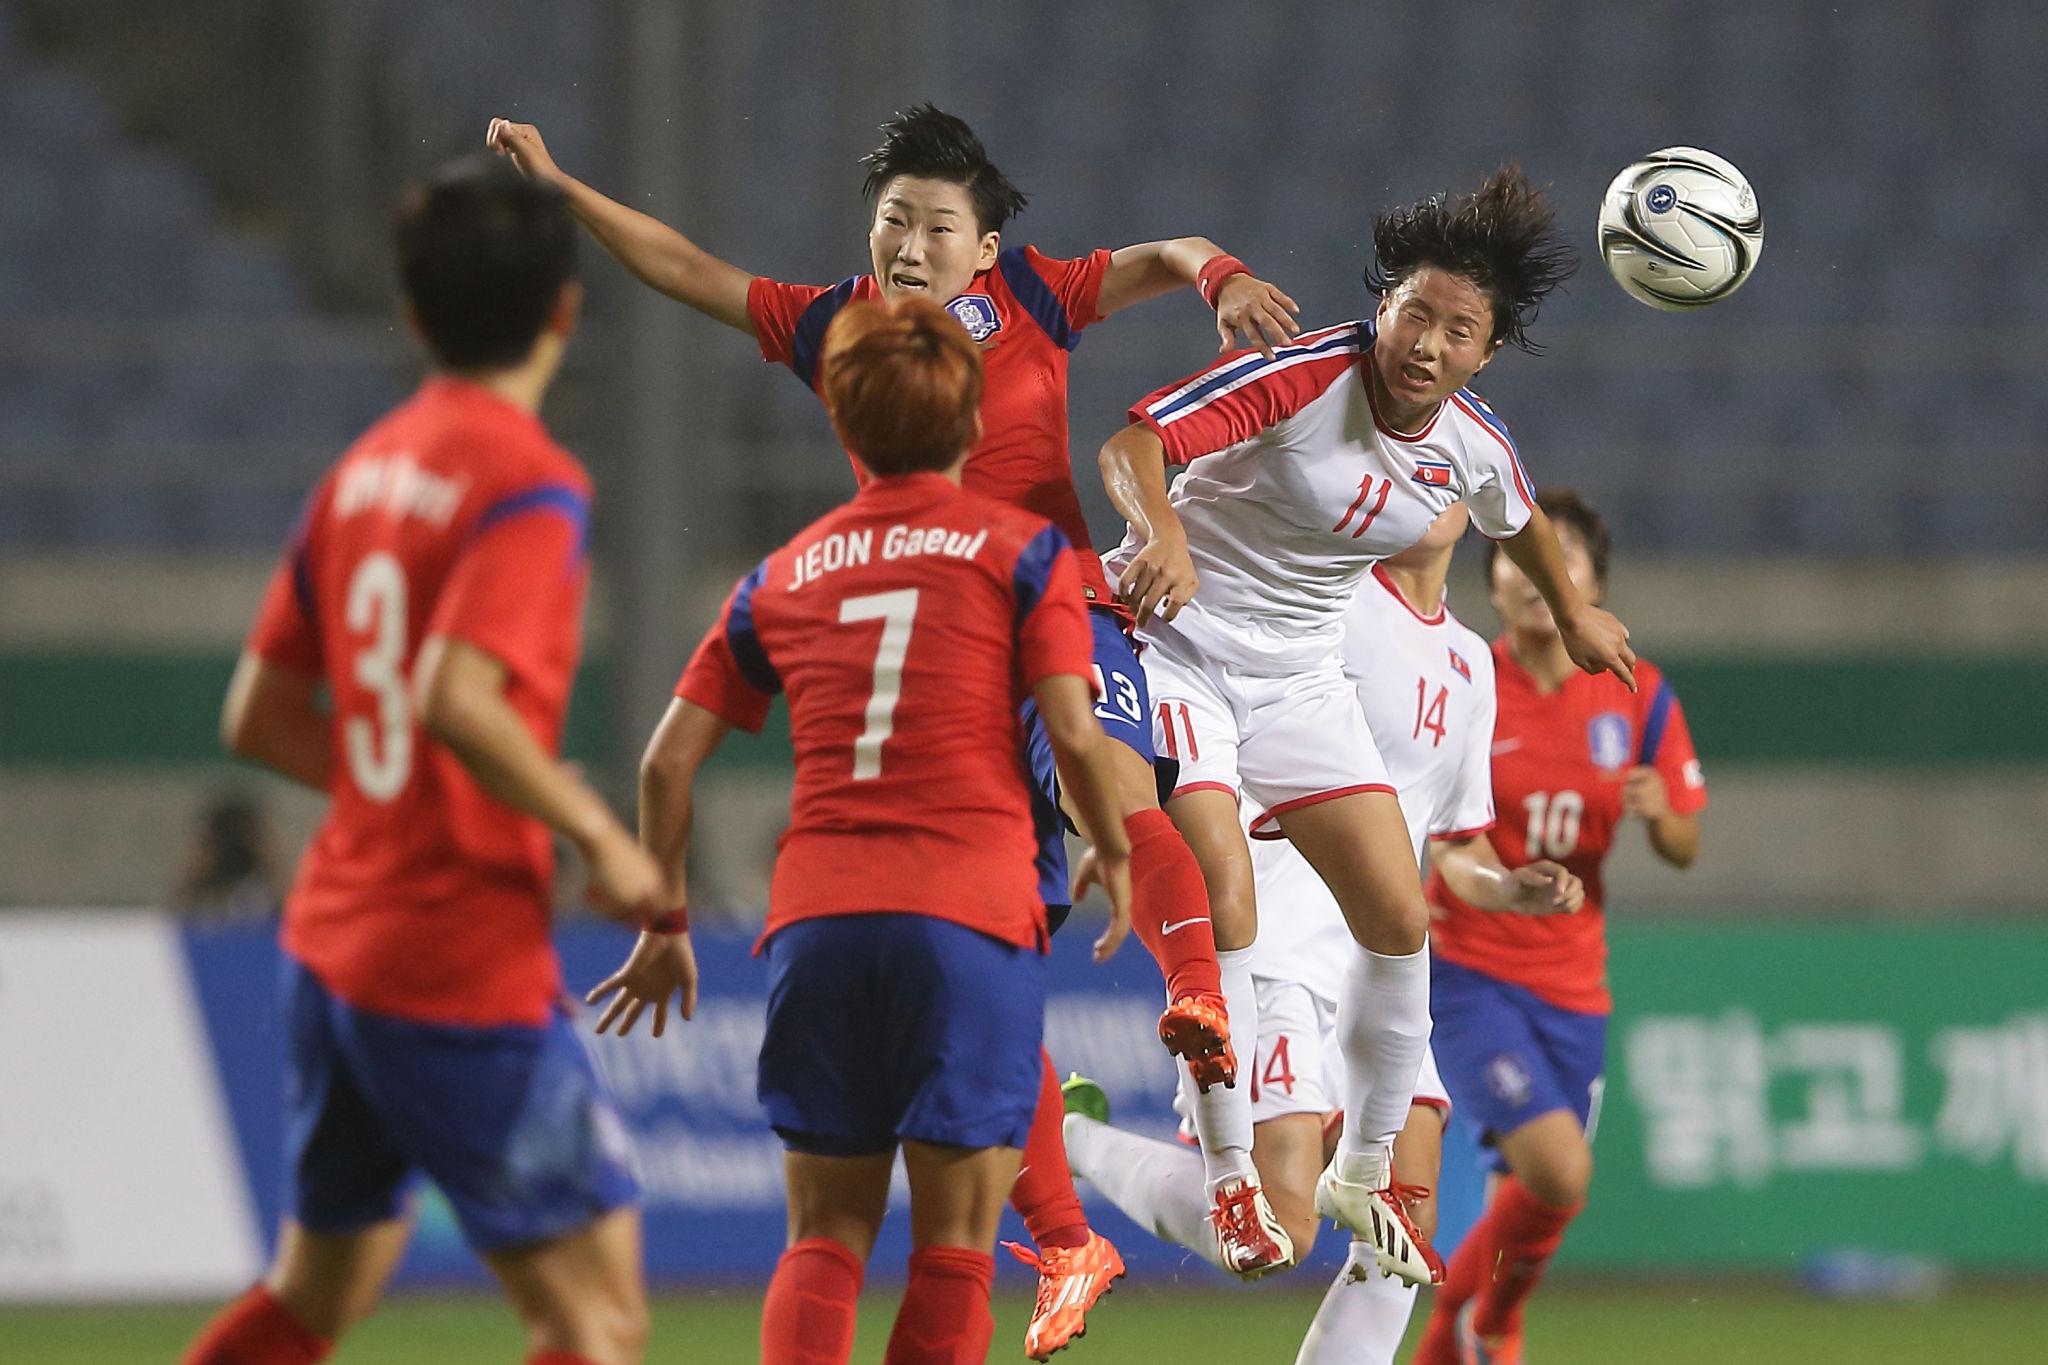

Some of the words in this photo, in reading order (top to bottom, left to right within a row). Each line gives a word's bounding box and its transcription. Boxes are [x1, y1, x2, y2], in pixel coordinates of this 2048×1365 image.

[1333, 473, 1392, 538] 11
[788, 530, 873, 592] JEON
[881, 524, 988, 561] Gaeul
[346, 552, 412, 806] 3
[838, 588, 920, 781] 7
[1411, 676, 1448, 747] 14
[1157, 702, 1199, 762] 11
[1523, 790, 1585, 858] 10
